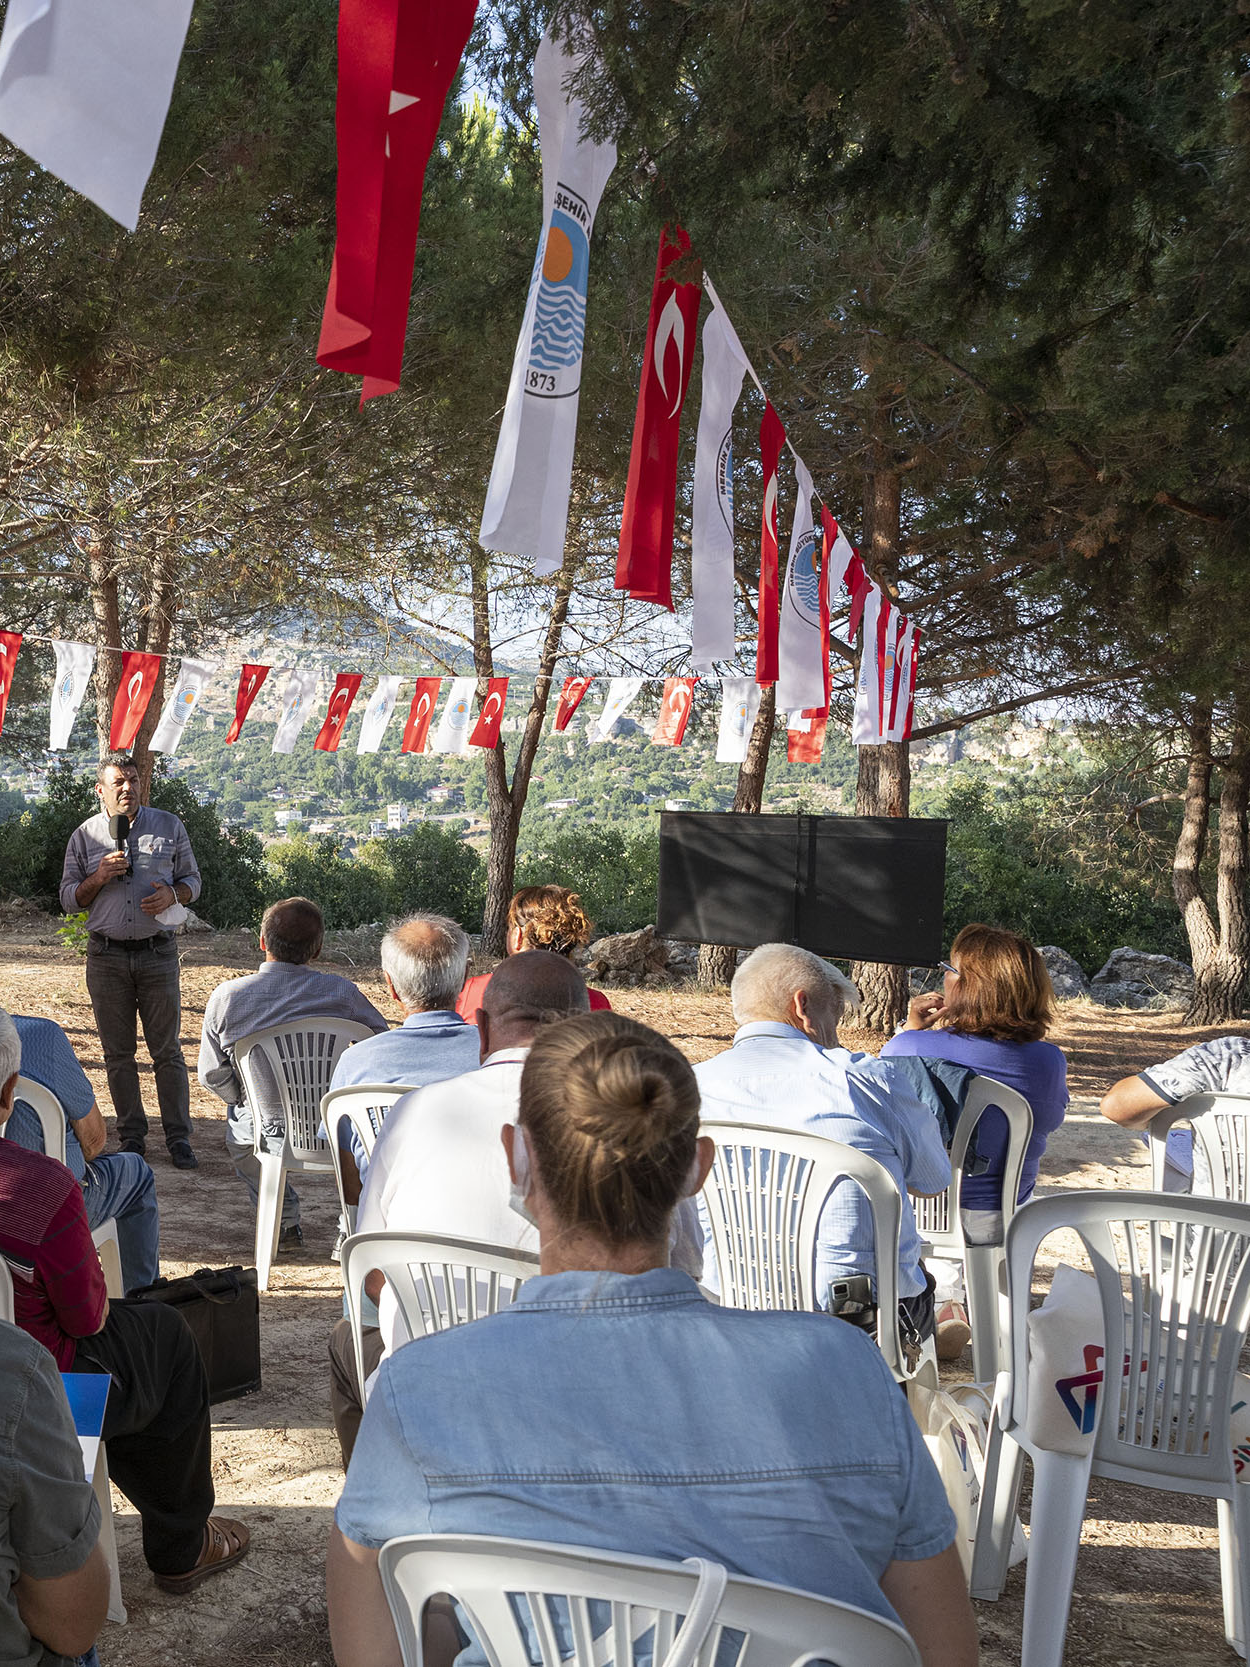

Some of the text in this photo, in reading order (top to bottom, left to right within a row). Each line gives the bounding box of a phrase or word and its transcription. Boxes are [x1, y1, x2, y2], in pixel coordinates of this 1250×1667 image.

[554, 191, 587, 227] ŞEHİR
[525, 369, 556, 391] 1873
[720, 451, 728, 495] MERSİN
